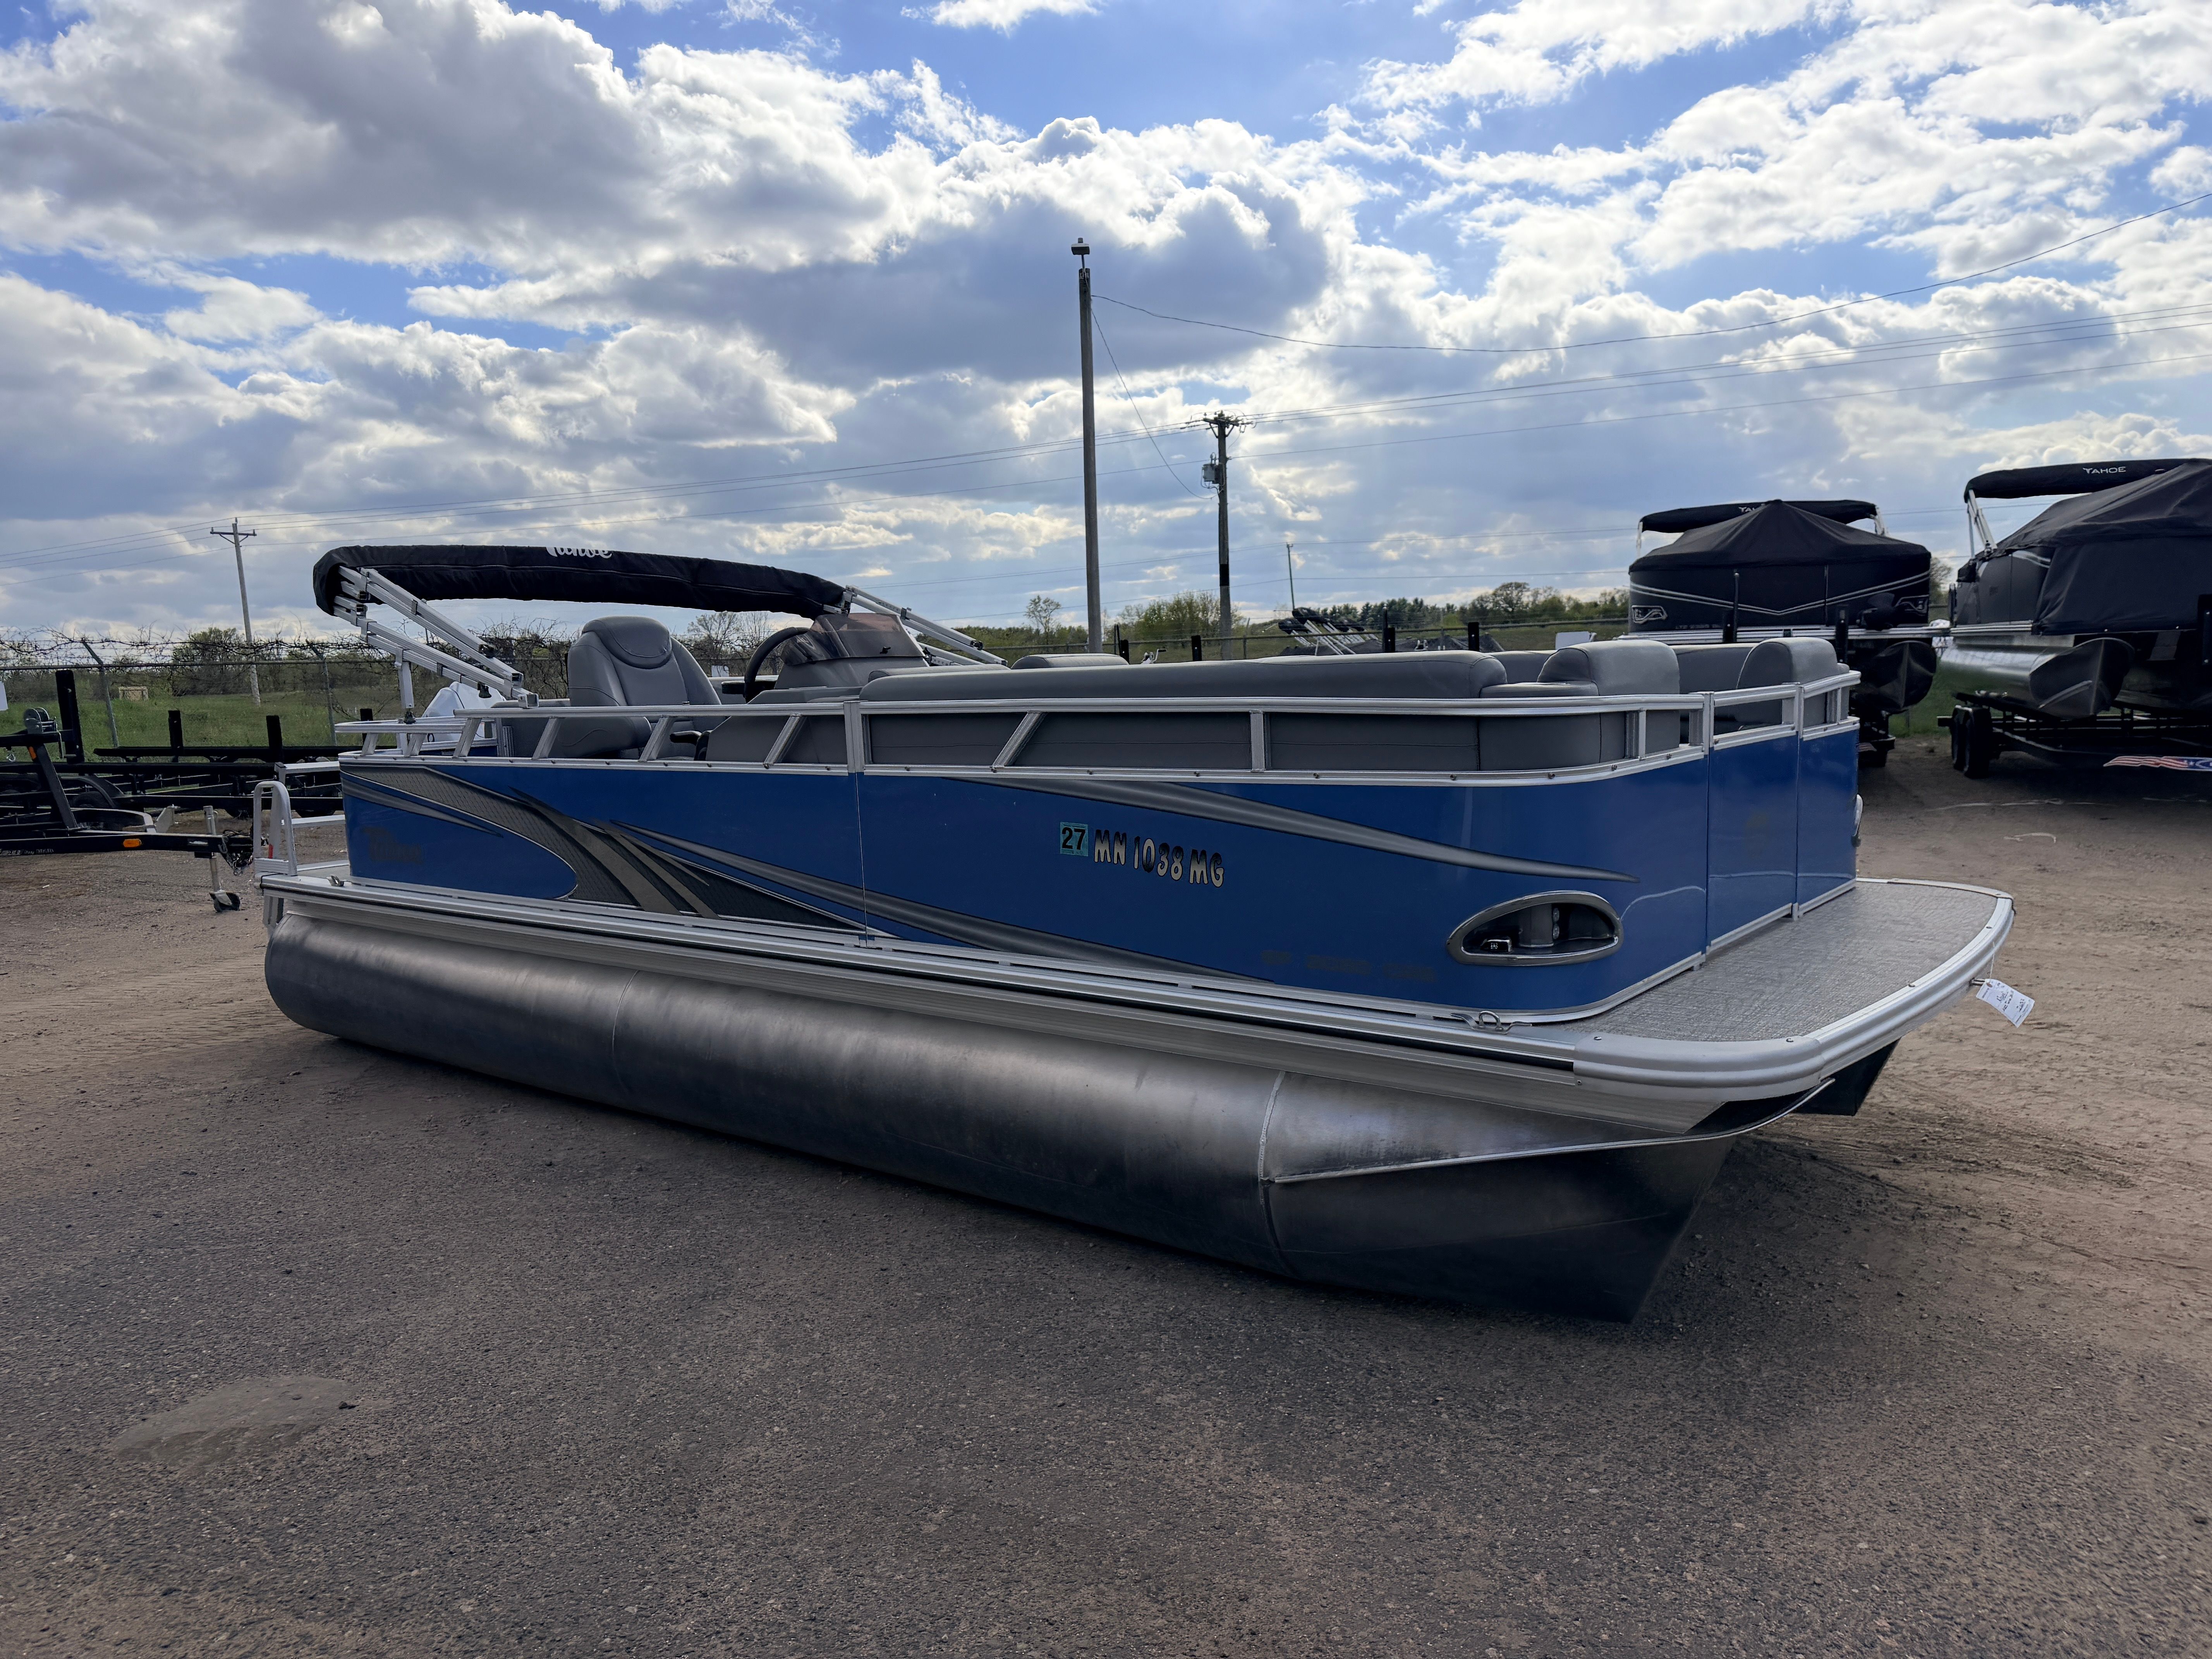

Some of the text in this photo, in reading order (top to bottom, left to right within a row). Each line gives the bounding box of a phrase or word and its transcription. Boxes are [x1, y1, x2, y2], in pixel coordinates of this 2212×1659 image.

[1062, 827, 1085, 850] 27
[1093, 829, 1224, 888] MN 1038 MG
